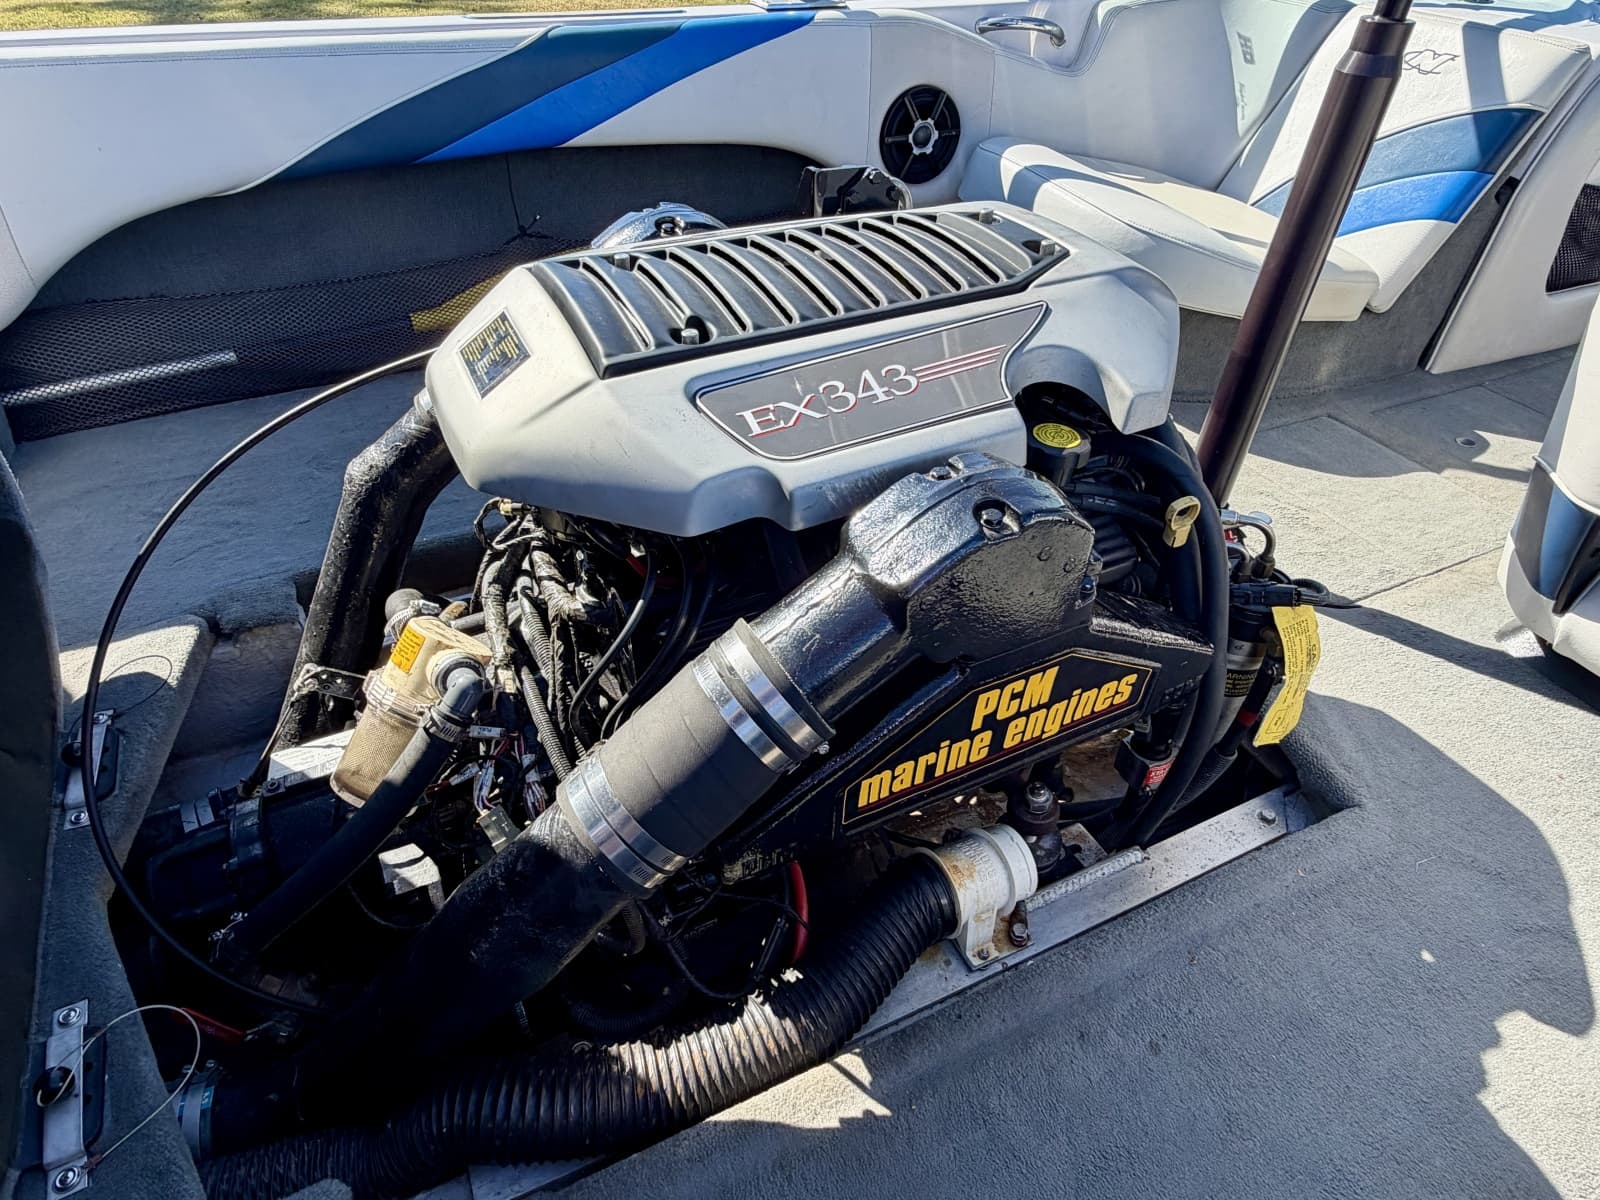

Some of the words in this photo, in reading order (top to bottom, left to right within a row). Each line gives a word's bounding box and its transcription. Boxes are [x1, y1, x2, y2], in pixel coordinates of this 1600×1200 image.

[735, 364, 920, 438] EX343
[970, 665, 1060, 732] PCM
[857, 729, 993, 808] marine
[1002, 673, 1139, 749] engines
